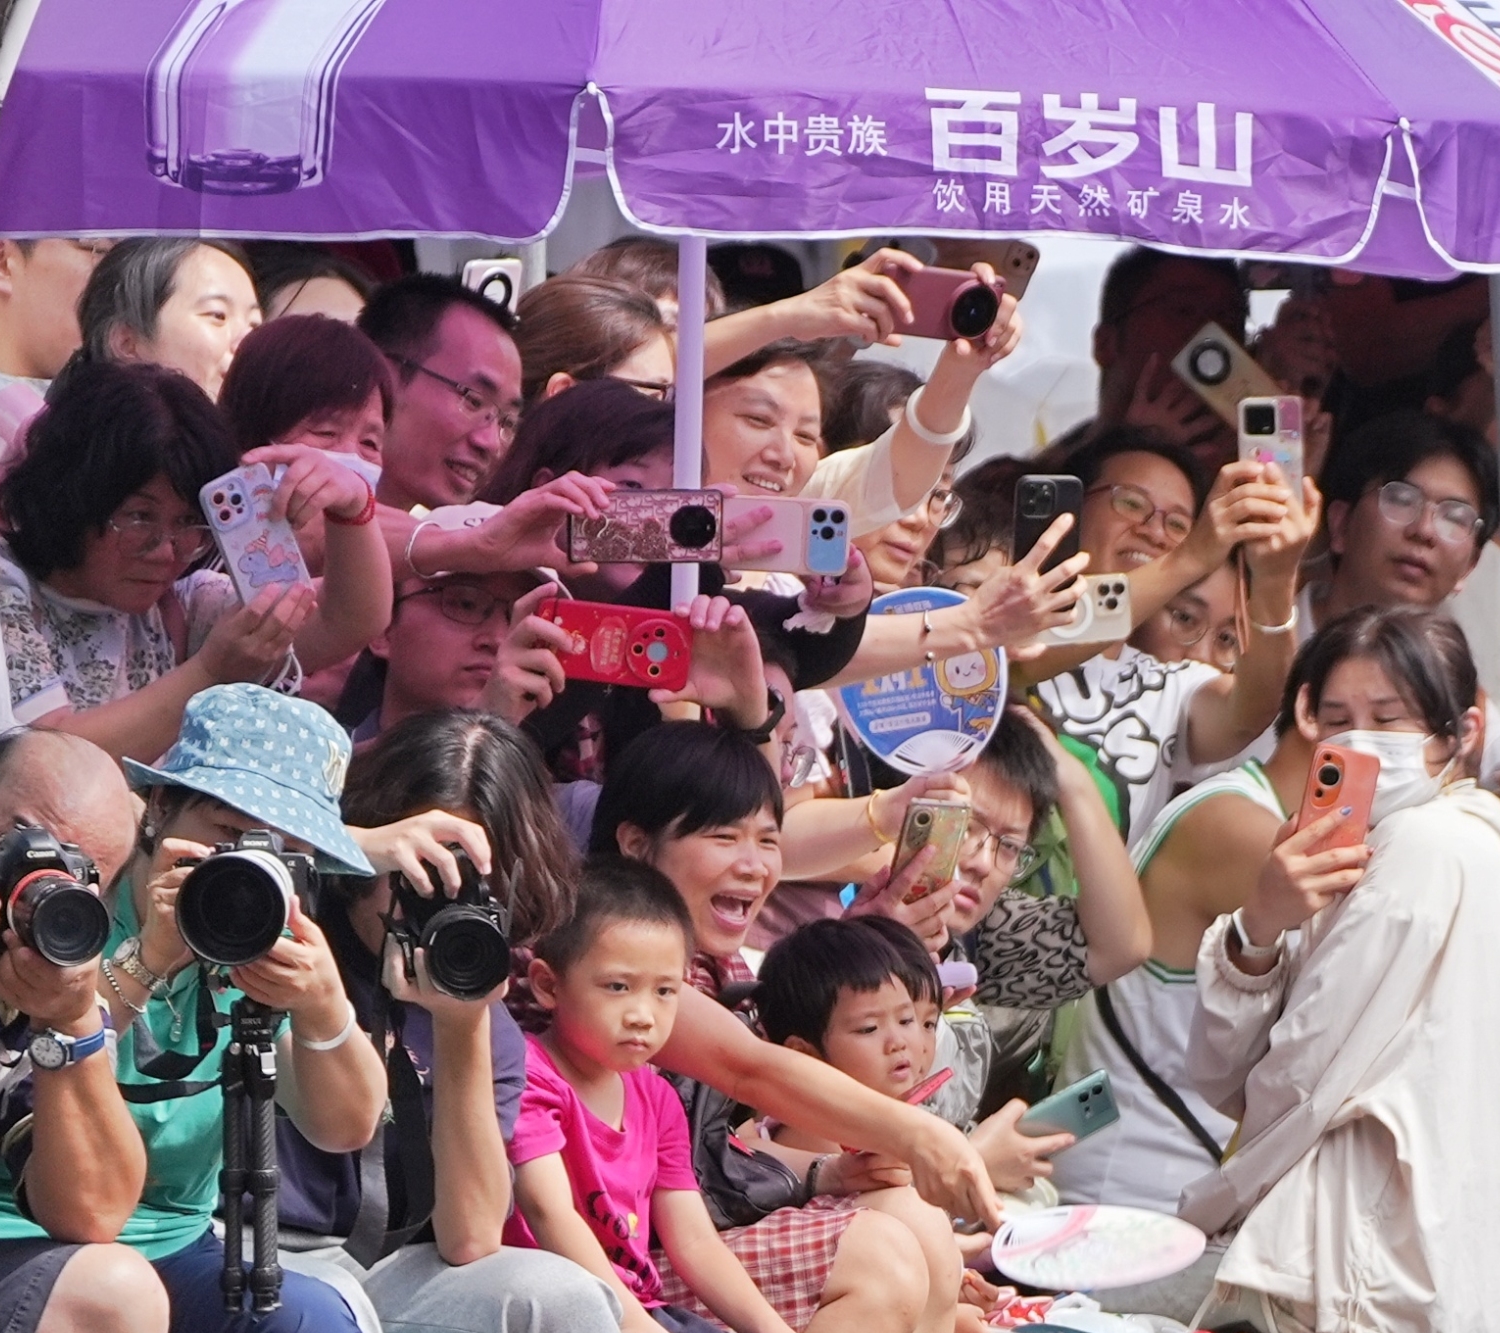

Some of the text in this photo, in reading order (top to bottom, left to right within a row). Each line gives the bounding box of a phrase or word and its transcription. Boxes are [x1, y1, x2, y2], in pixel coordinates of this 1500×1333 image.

[716, 112, 888, 157] 水中贵族
[925, 87, 1253, 187] 百岁山
[931, 178, 1251, 230] 饮用天然矿泉水
[26, 850, 57, 860] Canon
